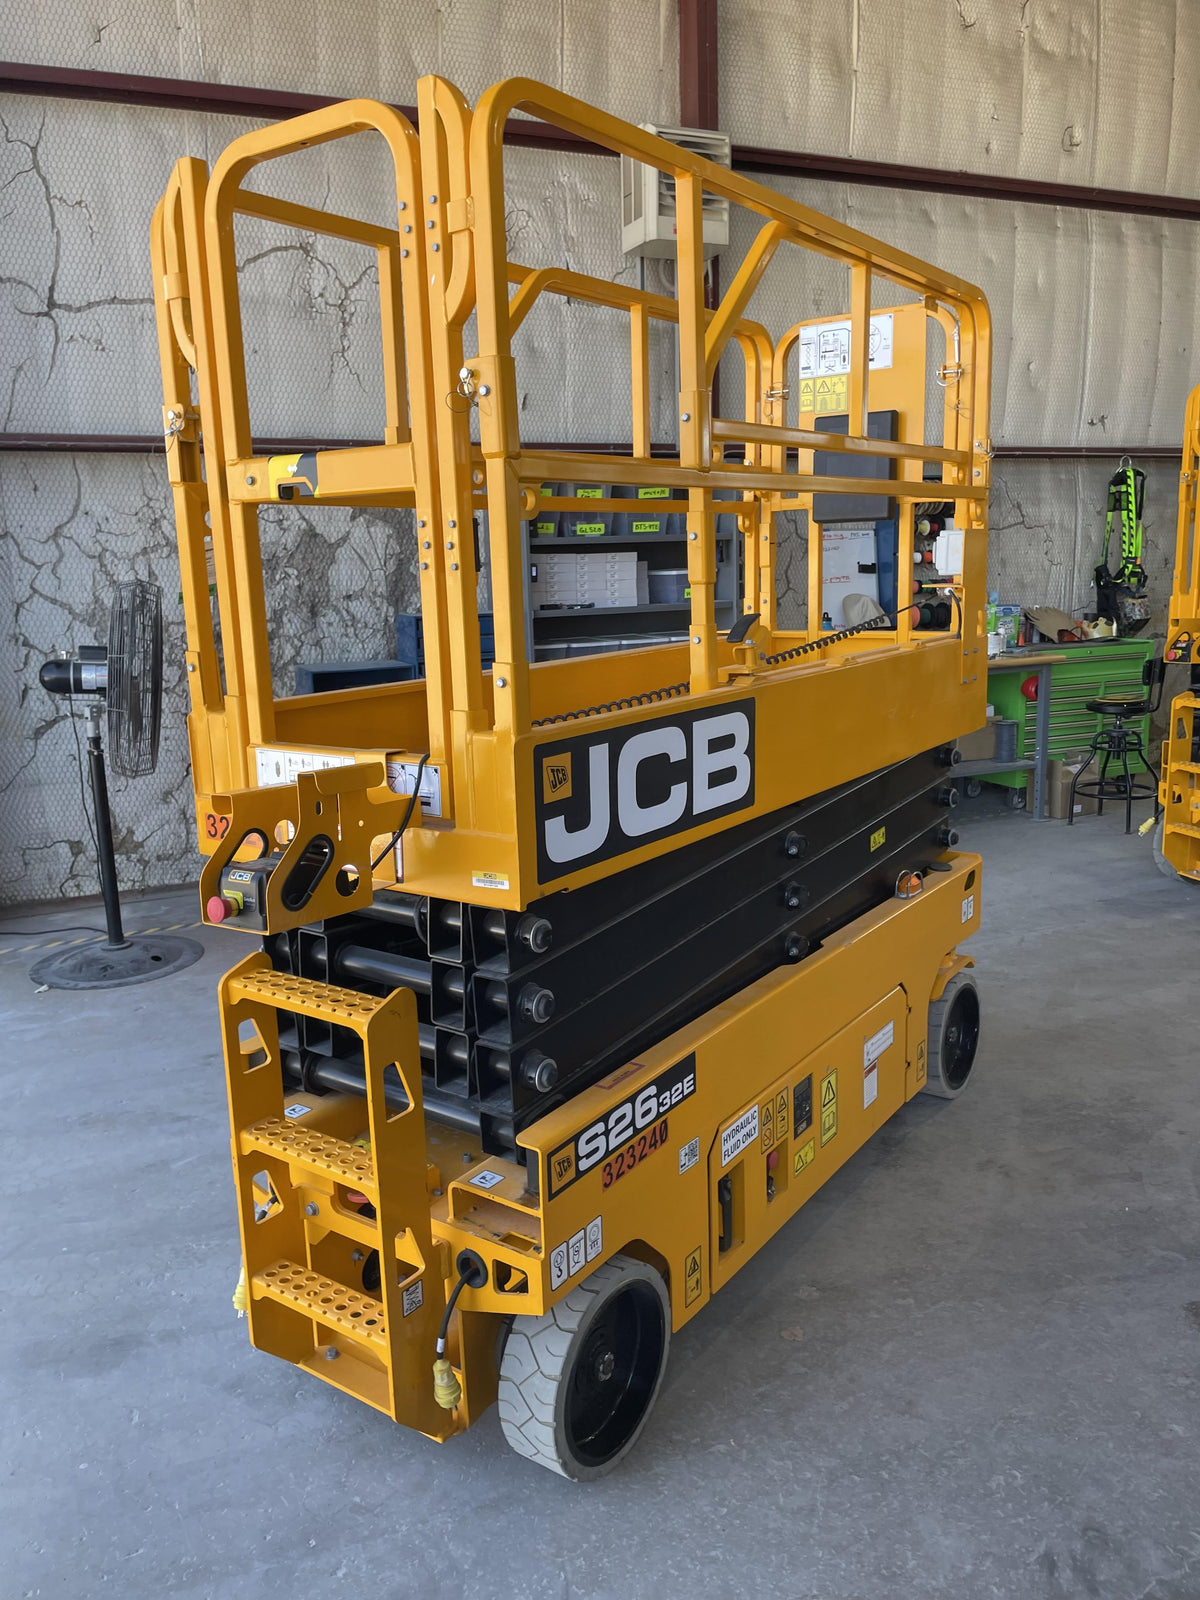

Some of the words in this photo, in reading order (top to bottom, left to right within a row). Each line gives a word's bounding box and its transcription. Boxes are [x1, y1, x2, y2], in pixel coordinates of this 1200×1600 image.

[544, 711, 751, 864] JCB
[549, 765, 569, 789] JCB
[230, 871, 251, 881] JCB
[723, 1110, 758, 1147] HYDRAULIC
[723, 1140, 741, 1161] FLUID
[741, 1125, 758, 1147] ONLY
[555, 1155, 573, 1180] JCB
[602, 1118, 669, 1190] 323240
